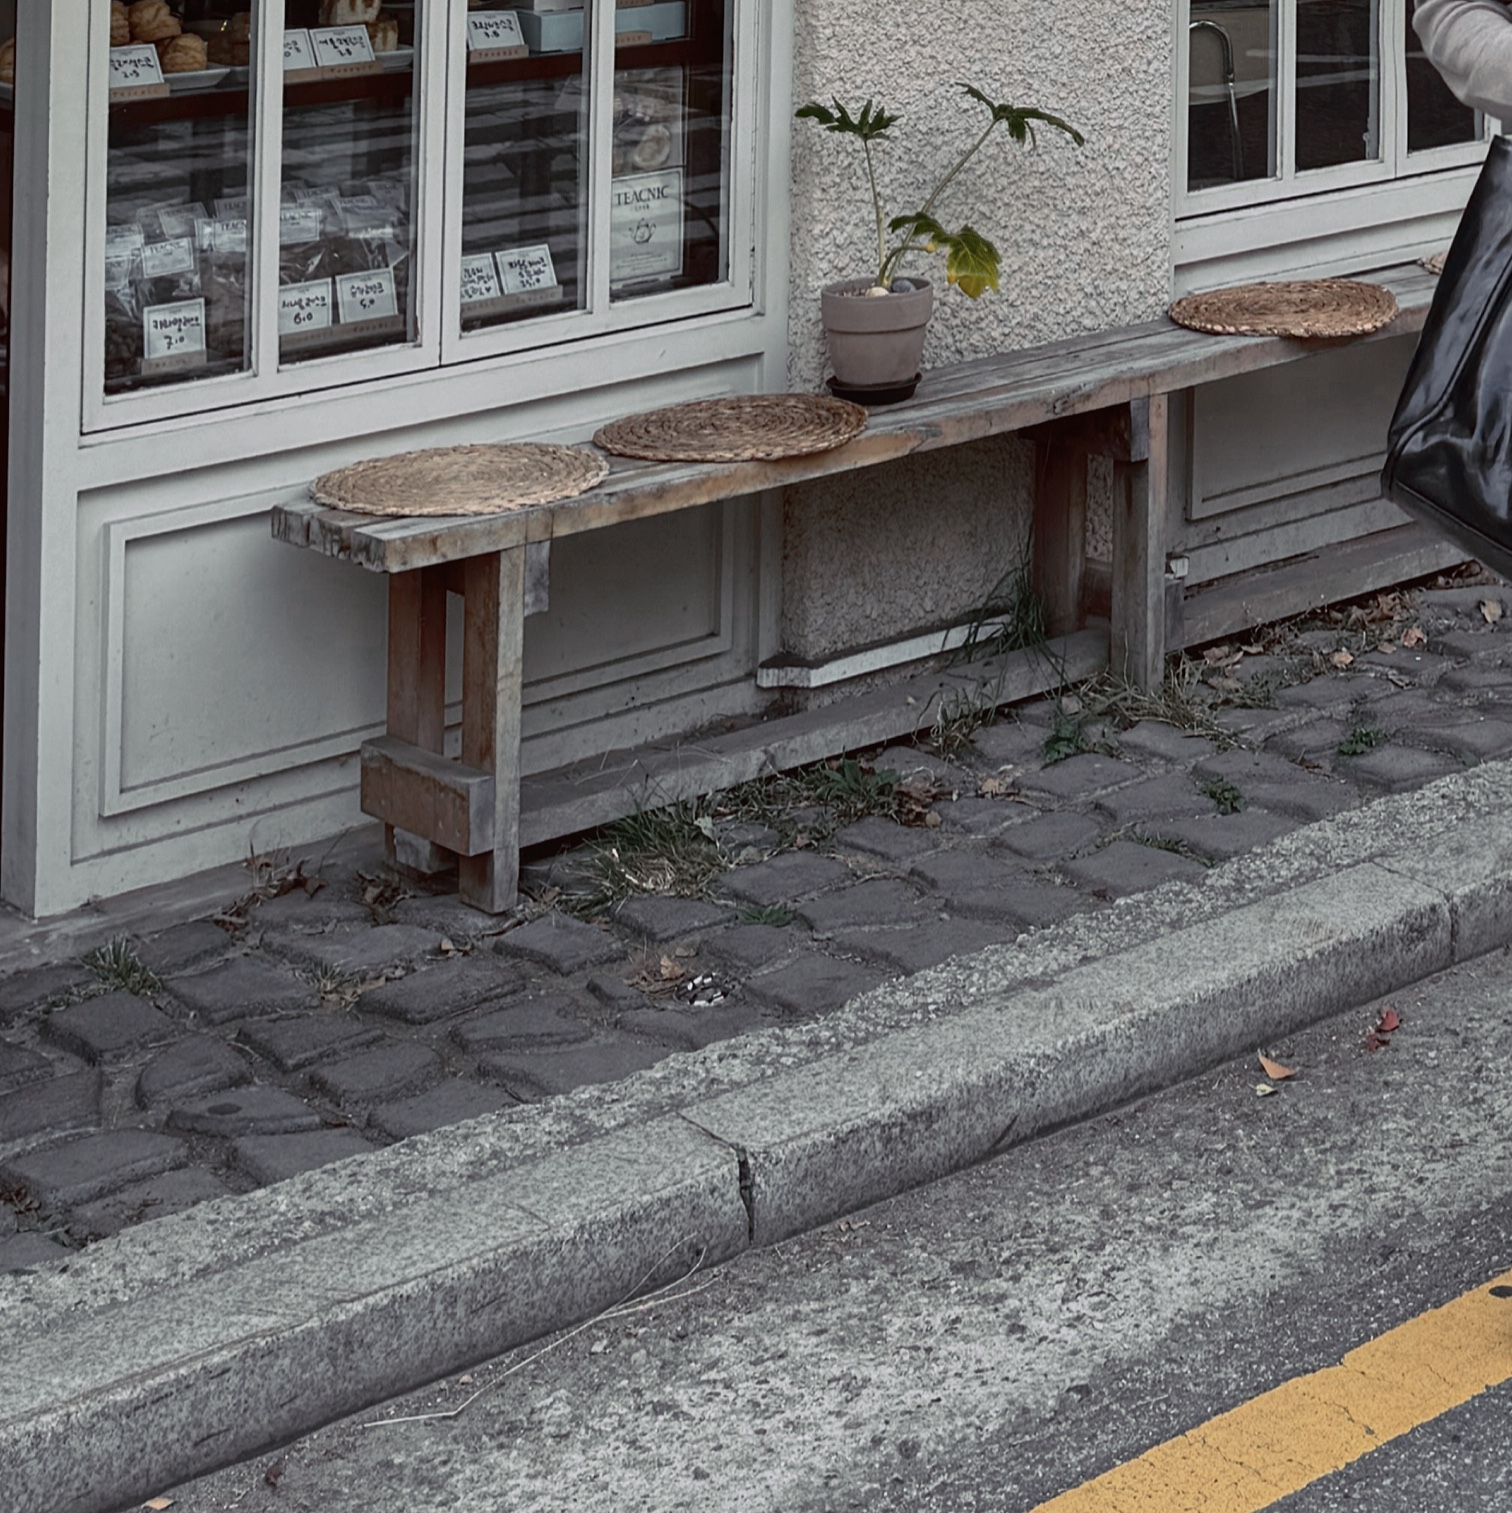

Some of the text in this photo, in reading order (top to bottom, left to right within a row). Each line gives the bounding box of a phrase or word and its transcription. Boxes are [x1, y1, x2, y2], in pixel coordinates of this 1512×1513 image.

[616, 185, 670, 206] TEACNIC
[293, 312, 314, 325] 6.0
[163, 335, 185, 350] 7.0
